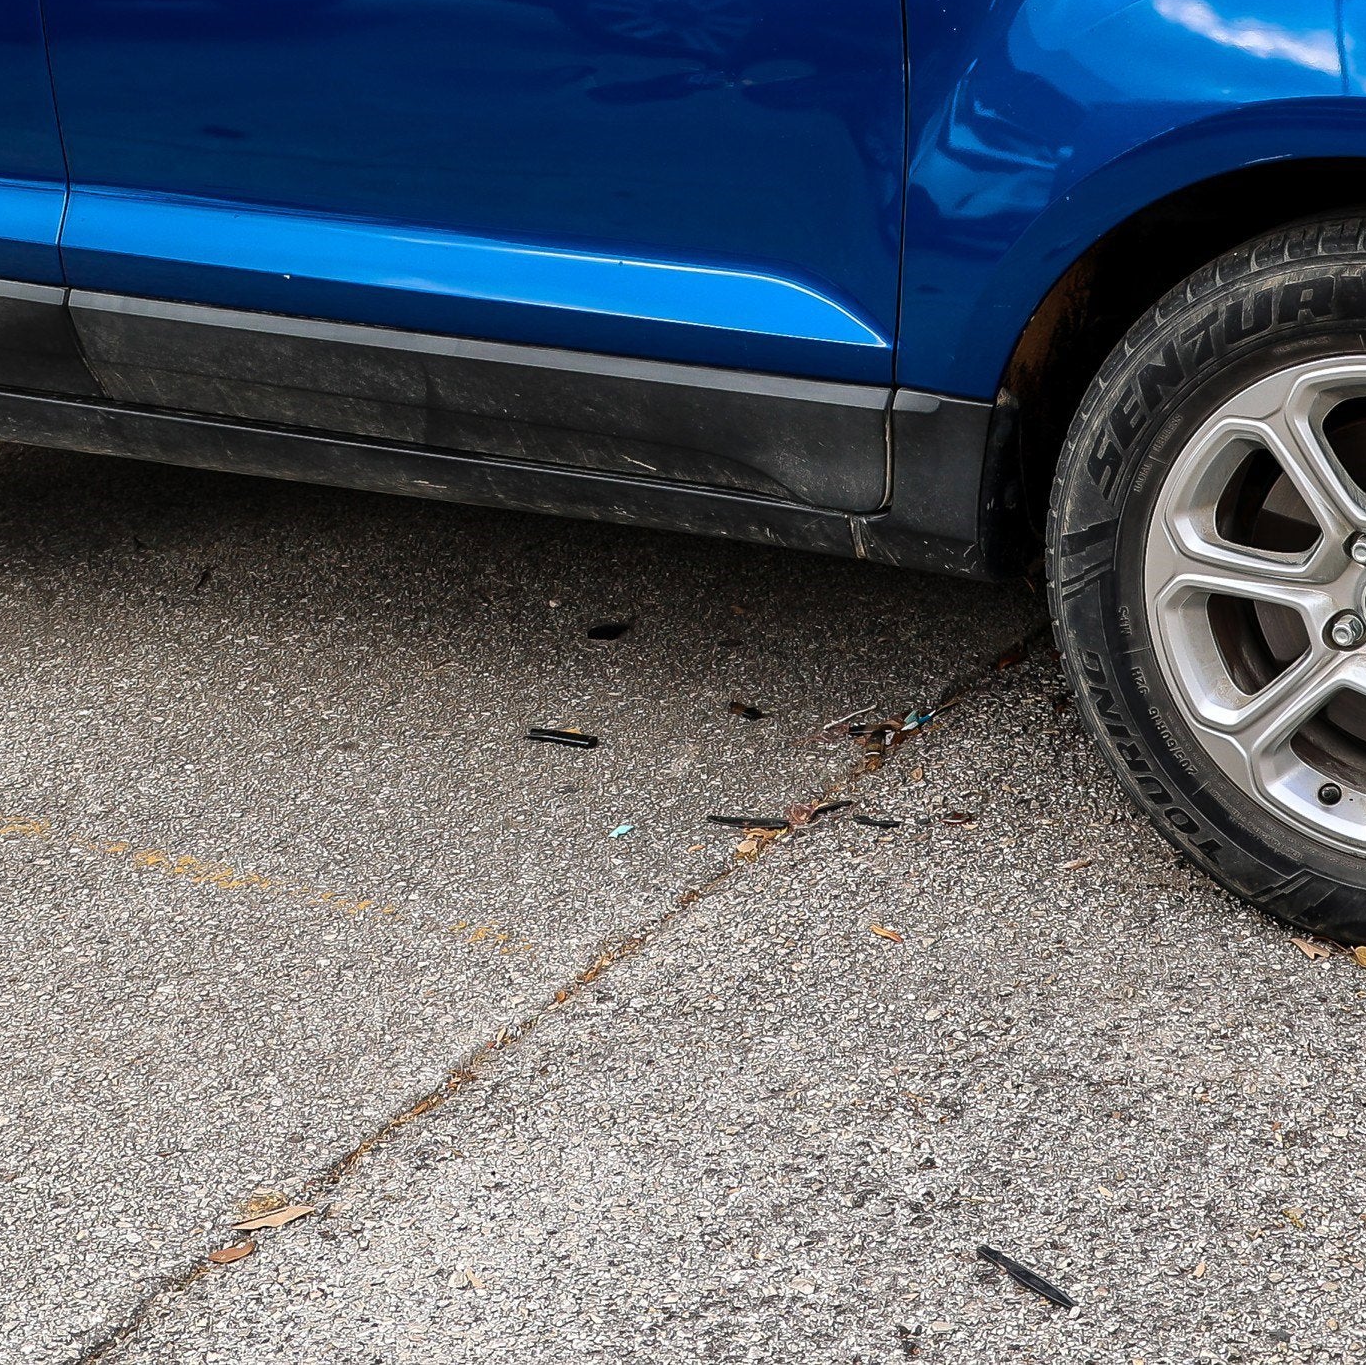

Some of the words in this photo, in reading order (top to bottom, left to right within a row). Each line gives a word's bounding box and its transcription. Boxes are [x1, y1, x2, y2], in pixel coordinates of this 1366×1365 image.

[1131, 667, 1151, 696] 92H
[1082, 649, 1225, 866] TOURING
[1147, 706, 1199, 776] 205/60R16
